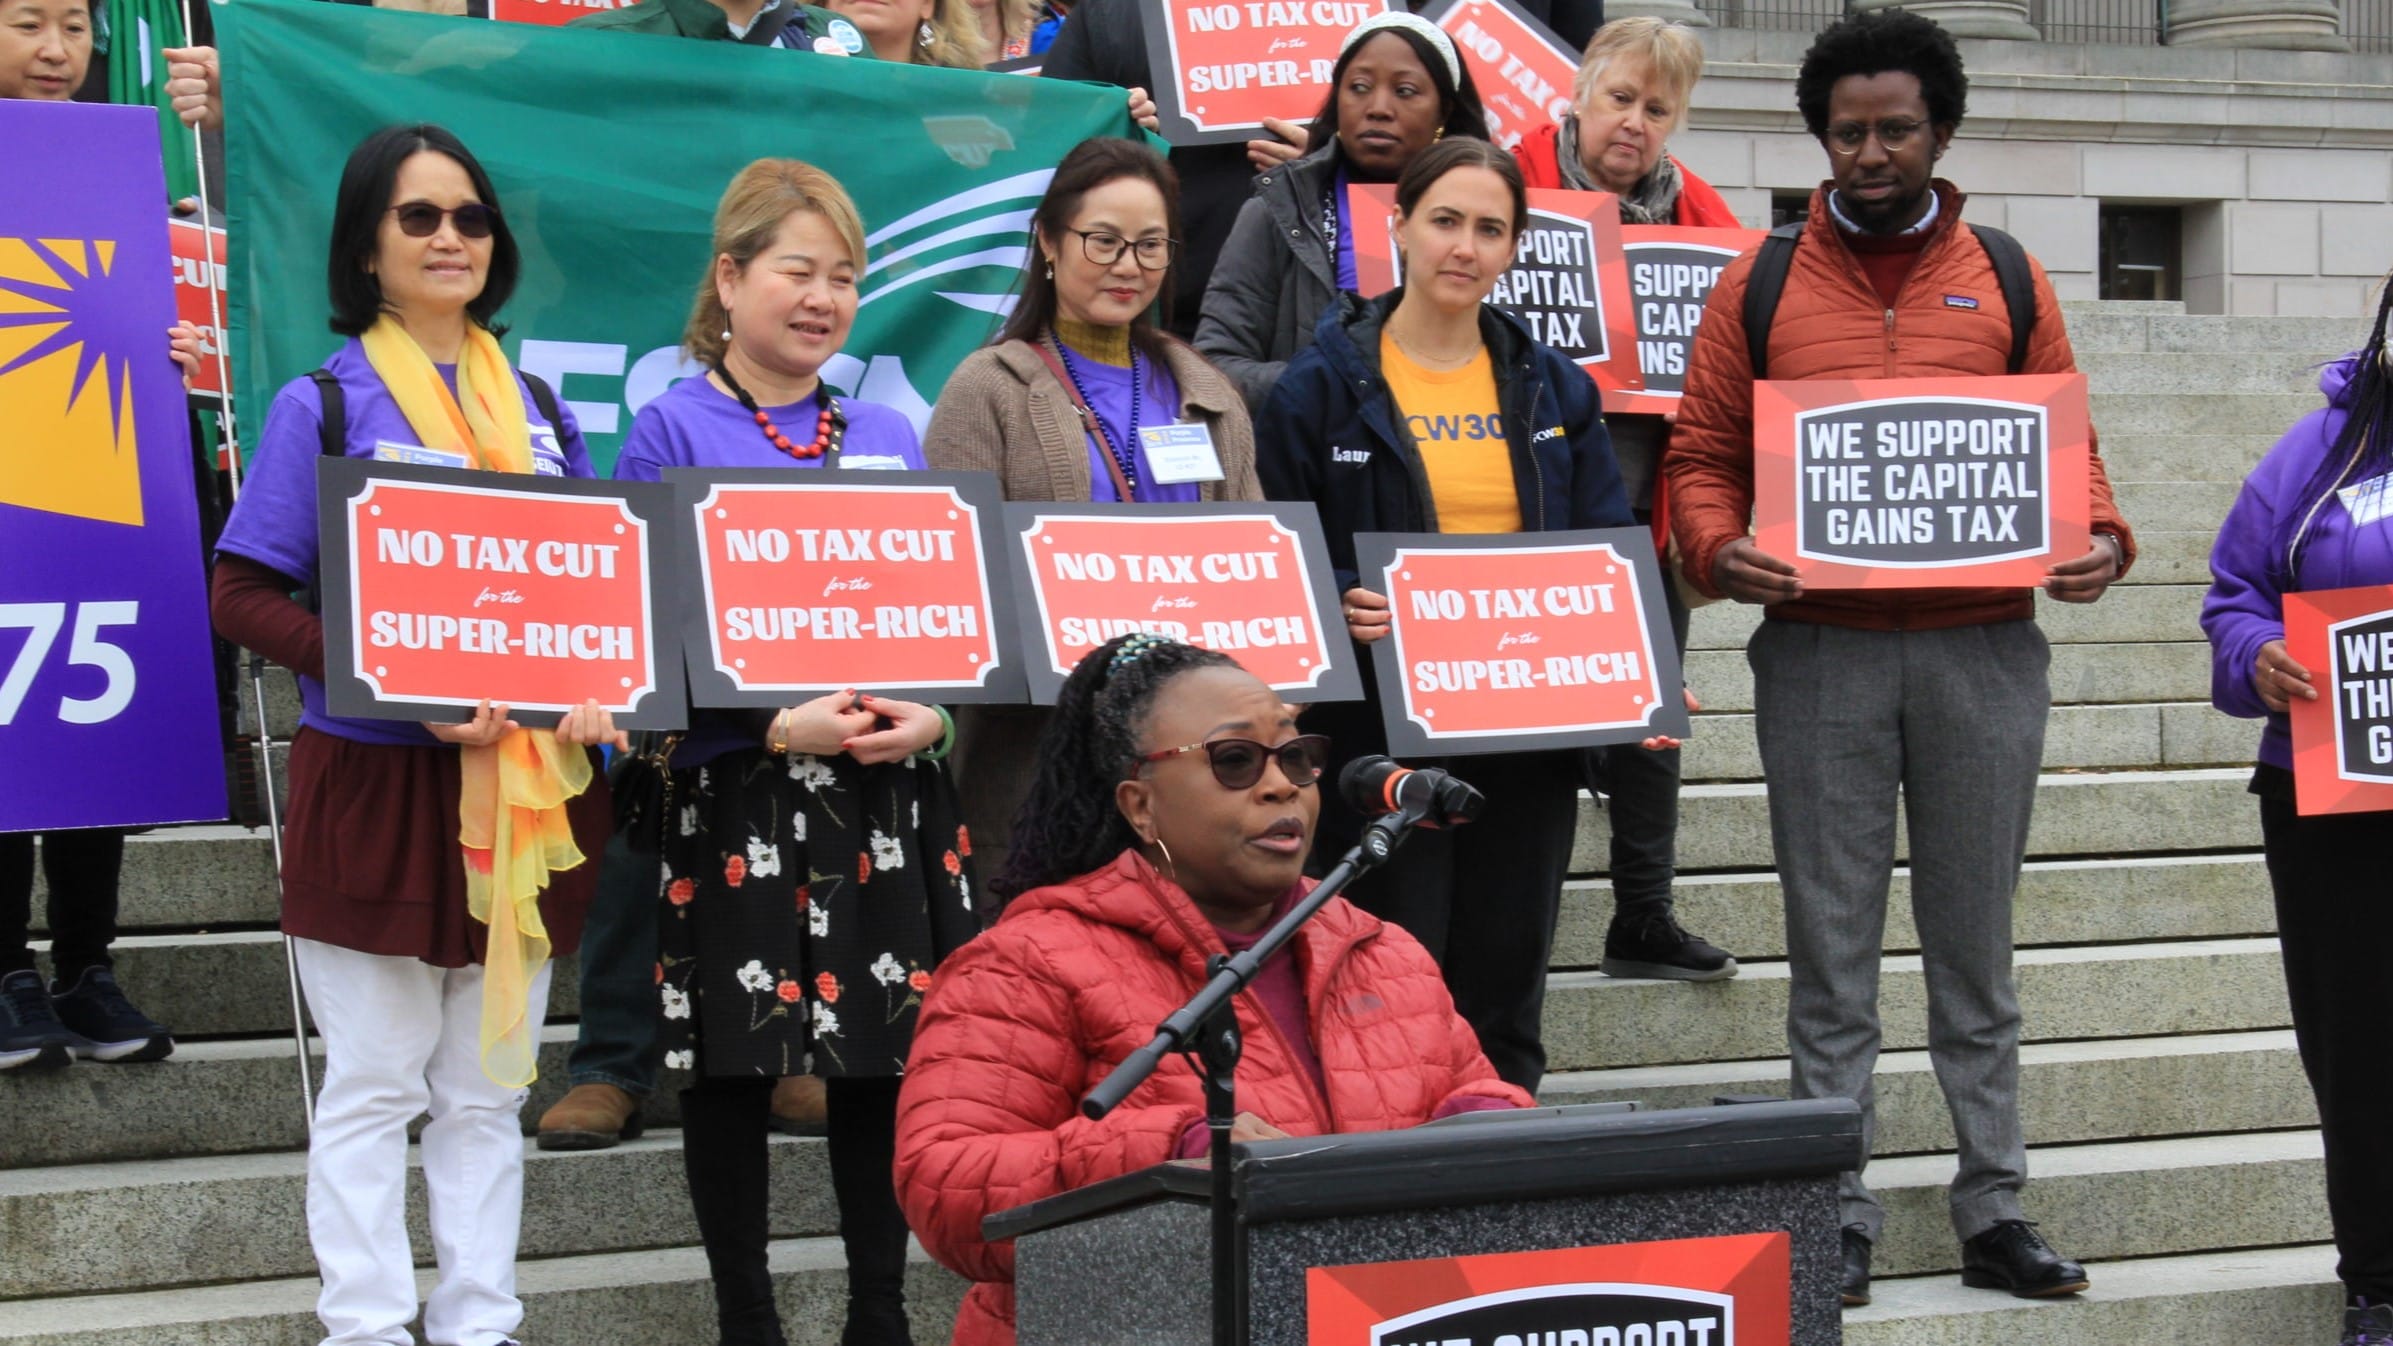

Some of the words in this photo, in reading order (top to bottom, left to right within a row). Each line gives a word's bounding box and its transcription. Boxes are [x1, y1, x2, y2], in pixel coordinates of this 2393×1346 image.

[1187, 4, 1240, 32] NO
[1244, 1, 1308, 28] TAX
[1311, 1, 1370, 27] CUT
[1268, 37, 1287, 54] for
[1287, 37, 1307, 48] the
[1189, 59, 1338, 93] SUPER-R
[1454, 20, 1503, 63] NO
[1500, 52, 1556, 109] TAX
[1518, 229, 1585, 266] PORT
[1482, 270, 1594, 308] APITAL
[1634, 263, 1725, 298] SUPP
[1526, 311, 1587, 349] TAX
[1636, 341, 1684, 375] INS
[1808, 422, 1863, 459] WE
[1877, 418, 2036, 458] SUPPORT
[1806, 465, 1871, 502] THE
[1884, 461, 2038, 501] CAPITAL
[1827, 507, 1934, 545] GAINS
[1946, 505, 2019, 543] TAX
[377, 527, 444, 567] NO
[451, 533, 530, 574] TAX
[535, 540, 620, 578] CUT
[724, 529, 790, 562] NO
[795, 529, 876, 561] TAX
[879, 529, 956, 561] CUT
[1052, 552, 1115, 582] NO
[1119, 554, 1199, 583] TAX
[1201, 551, 1278, 582] CUT
[473, 587, 499, 607] for
[499, 589, 526, 604] the
[823, 576, 847, 597] for
[847, 577, 873, 591] the
[1151, 596, 1174, 612] for
[1174, 596, 1199, 608] the
[1409, 589, 1466, 621] NO
[1469, 588, 1541, 619] TAX
[1543, 583, 1614, 617] CUT
[370, 611, 634, 660] SUPER-RICH
[724, 605, 979, 641] SUPER-RICH
[1497, 632, 1519, 652] for
[1519, 632, 1541, 645] the
[1414, 651, 1642, 693] SUPER-RICH
[2343, 678, 2393, 720] TH
